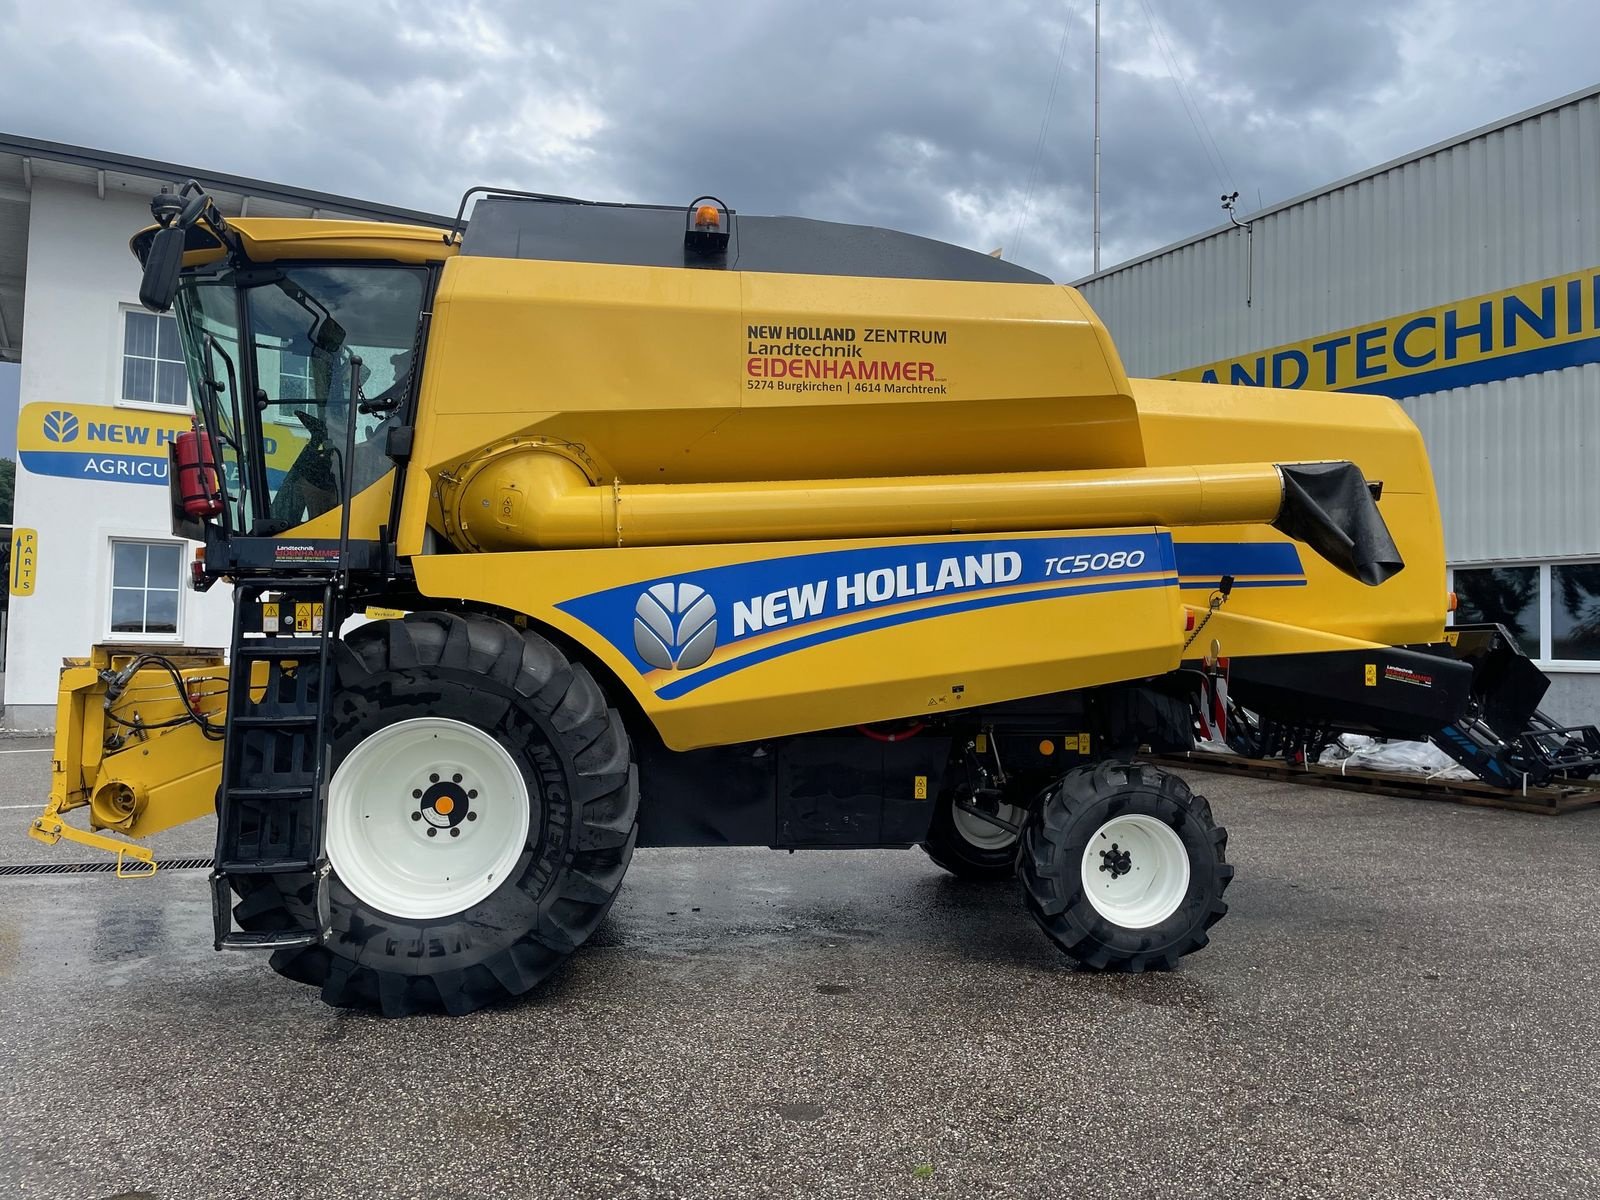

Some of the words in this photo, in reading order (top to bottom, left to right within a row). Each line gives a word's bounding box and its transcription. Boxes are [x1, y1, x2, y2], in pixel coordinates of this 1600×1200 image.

[747, 325, 782, 340] NEW
[786, 327, 856, 342] HOLLAND
[863, 328, 947, 345] ZENTRUM
[1168, 275, 1600, 389] NDTECHNI
[747, 341, 863, 358] Landtechnik
[747, 357, 935, 382] EIDENHAMMER
[747, 380, 775, 391] 5274
[777, 381, 843, 395] Burgkirchen
[854, 383, 881, 393] 4614
[884, 383, 947, 394] Marchtrenk
[87, 422, 150, 445] NEW
[23, 534, 33, 589] PARTS
[732, 580, 830, 636] NEW
[836, 550, 1024, 610] HOLLAND
[1044, 550, 1146, 576] TC5080
